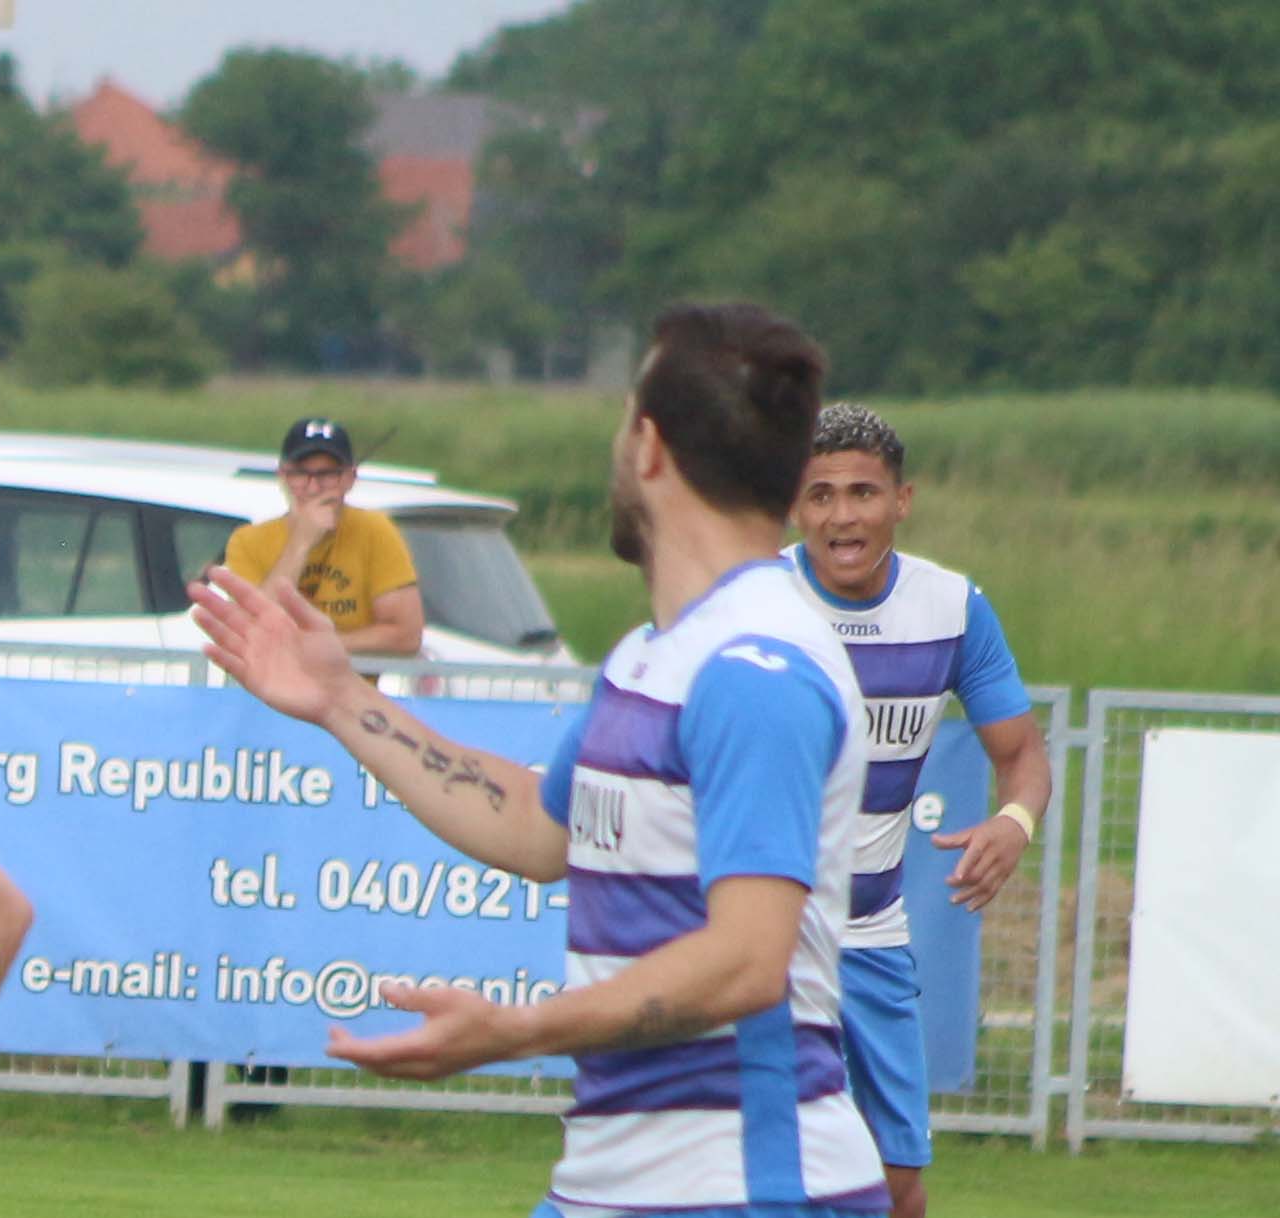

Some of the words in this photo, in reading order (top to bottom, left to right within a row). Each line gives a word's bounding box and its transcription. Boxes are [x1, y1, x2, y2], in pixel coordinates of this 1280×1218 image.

[57, 740, 334, 813] Republike
[209, 854, 298, 910] tel.
[317, 859, 570, 920] 040/821-
[21, 953, 200, 1000] e-mail:
[216, 955, 568, 1018] info@mnic
